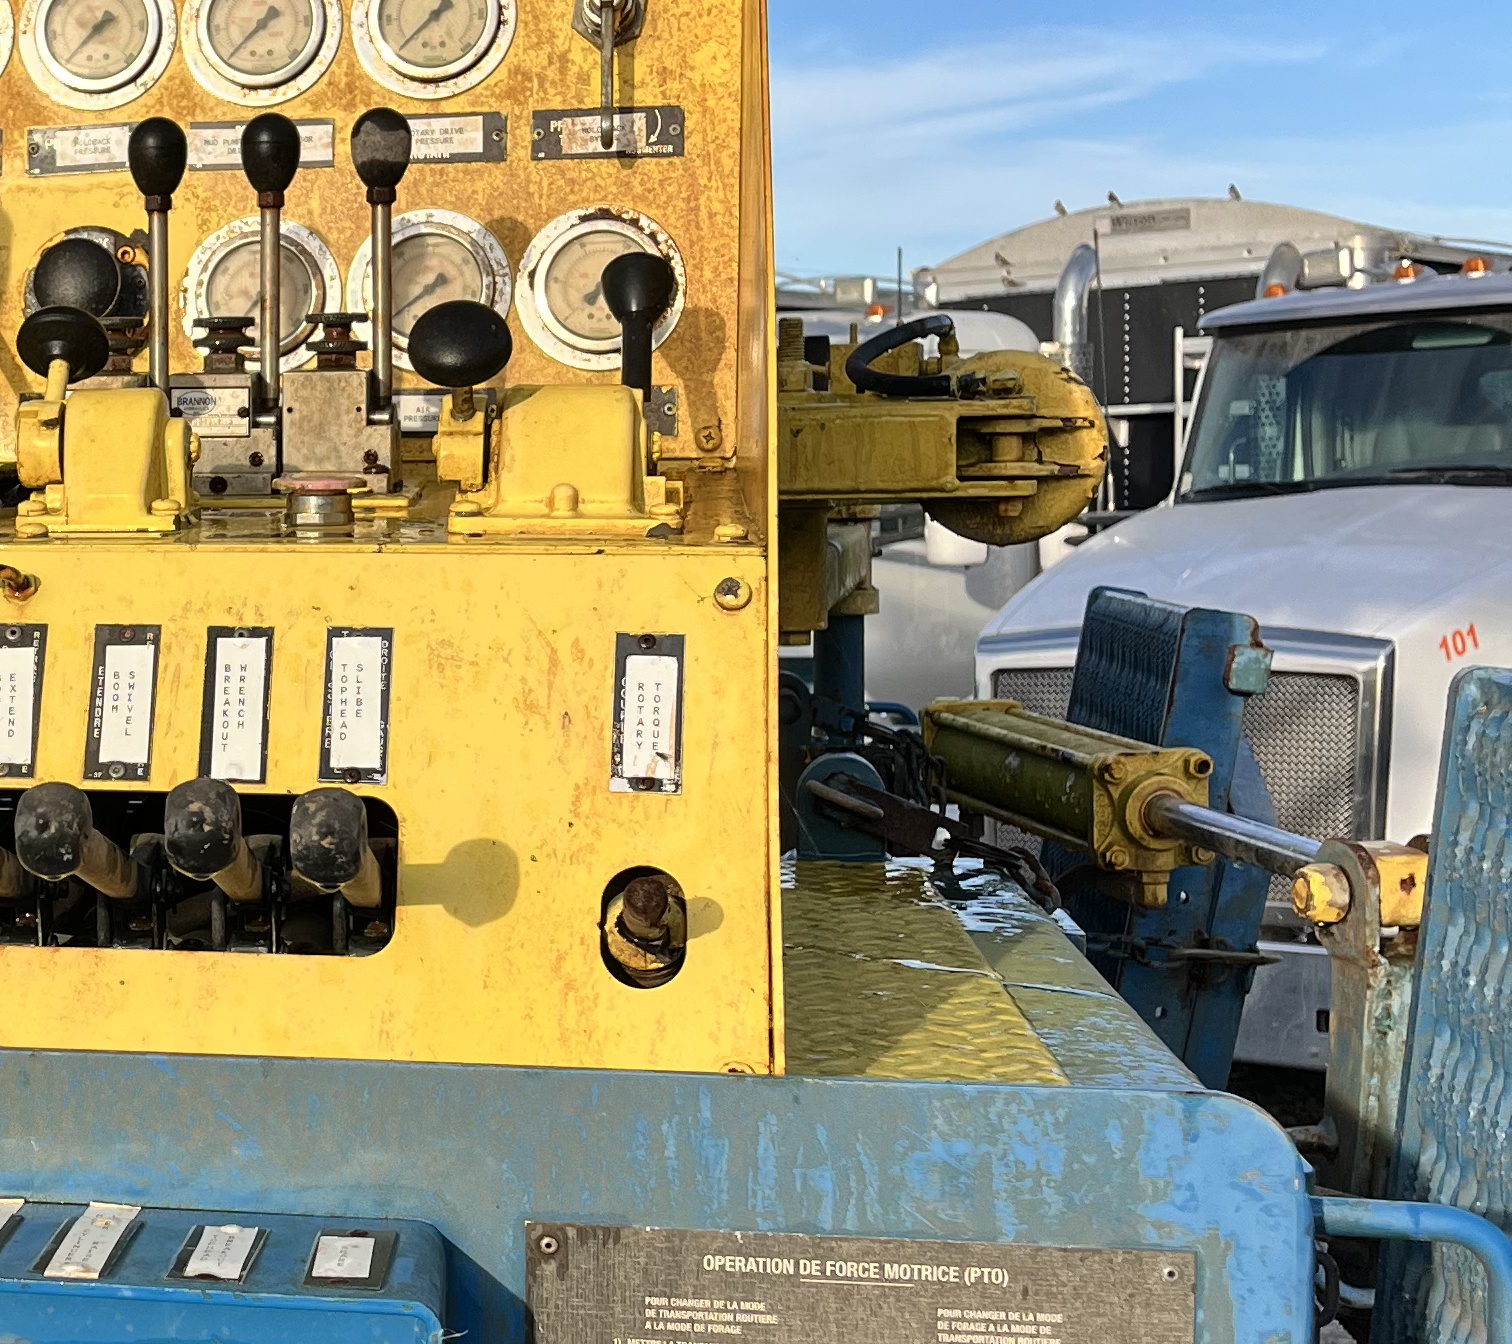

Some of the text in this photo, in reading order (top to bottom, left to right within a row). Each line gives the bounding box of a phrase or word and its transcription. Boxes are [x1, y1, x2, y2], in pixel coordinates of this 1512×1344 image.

[439, 127, 464, 136] DRIVE
[177, 397, 216, 406] BRANNON
[416, 406, 430, 414] AIR
[1437, 623, 1481, 662] 101
[7, 673, 17, 738] EXTEND
[93, 666, 105, 738] ETENDRE
[124, 671, 136, 736] SWIVEL
[221, 664, 232, 753] BREAKOUT
[237, 664, 248, 729] WRENCH
[339, 664, 349, 741] TOPHEAD
[635, 683, 646, 750] ROTARY
[651, 683, 662, 751] TORQUE
[703, 1254, 1008, 1286] OPERATION DE FORCE MOTRICE (PTO)
[645, 1297, 766, 1311] POUR CHANGER DE LA MODE
